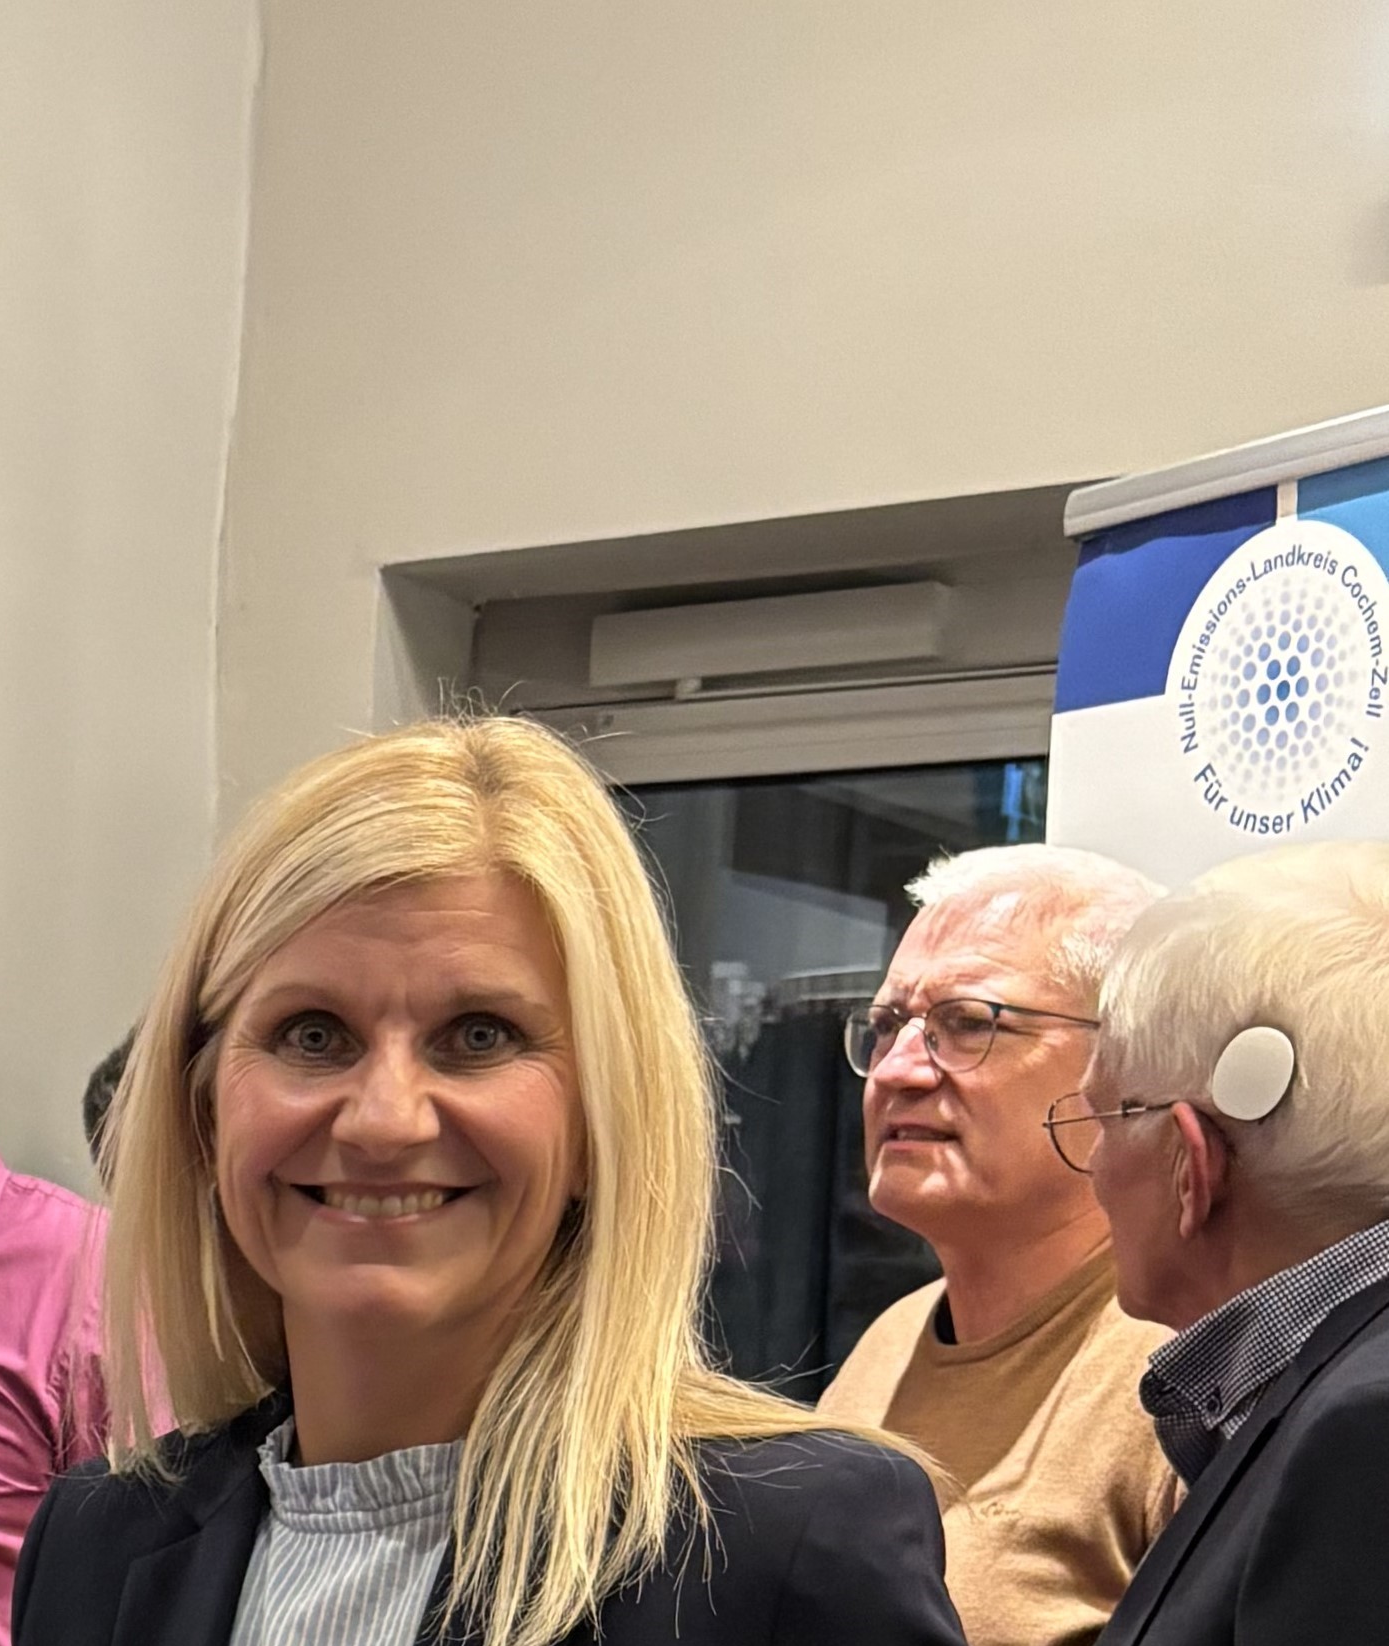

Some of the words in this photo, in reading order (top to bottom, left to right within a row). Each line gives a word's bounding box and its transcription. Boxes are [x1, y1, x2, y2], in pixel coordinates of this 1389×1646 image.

[1179, 544, 1338, 754] Null-Emissions-Landkreis
[1341, 565, 1388, 718] Cochem-Zell
[1193, 762, 1229, 814] Für
[1229, 805, 1294, 834] unser
[1300, 736, 1369, 824] Klima!
